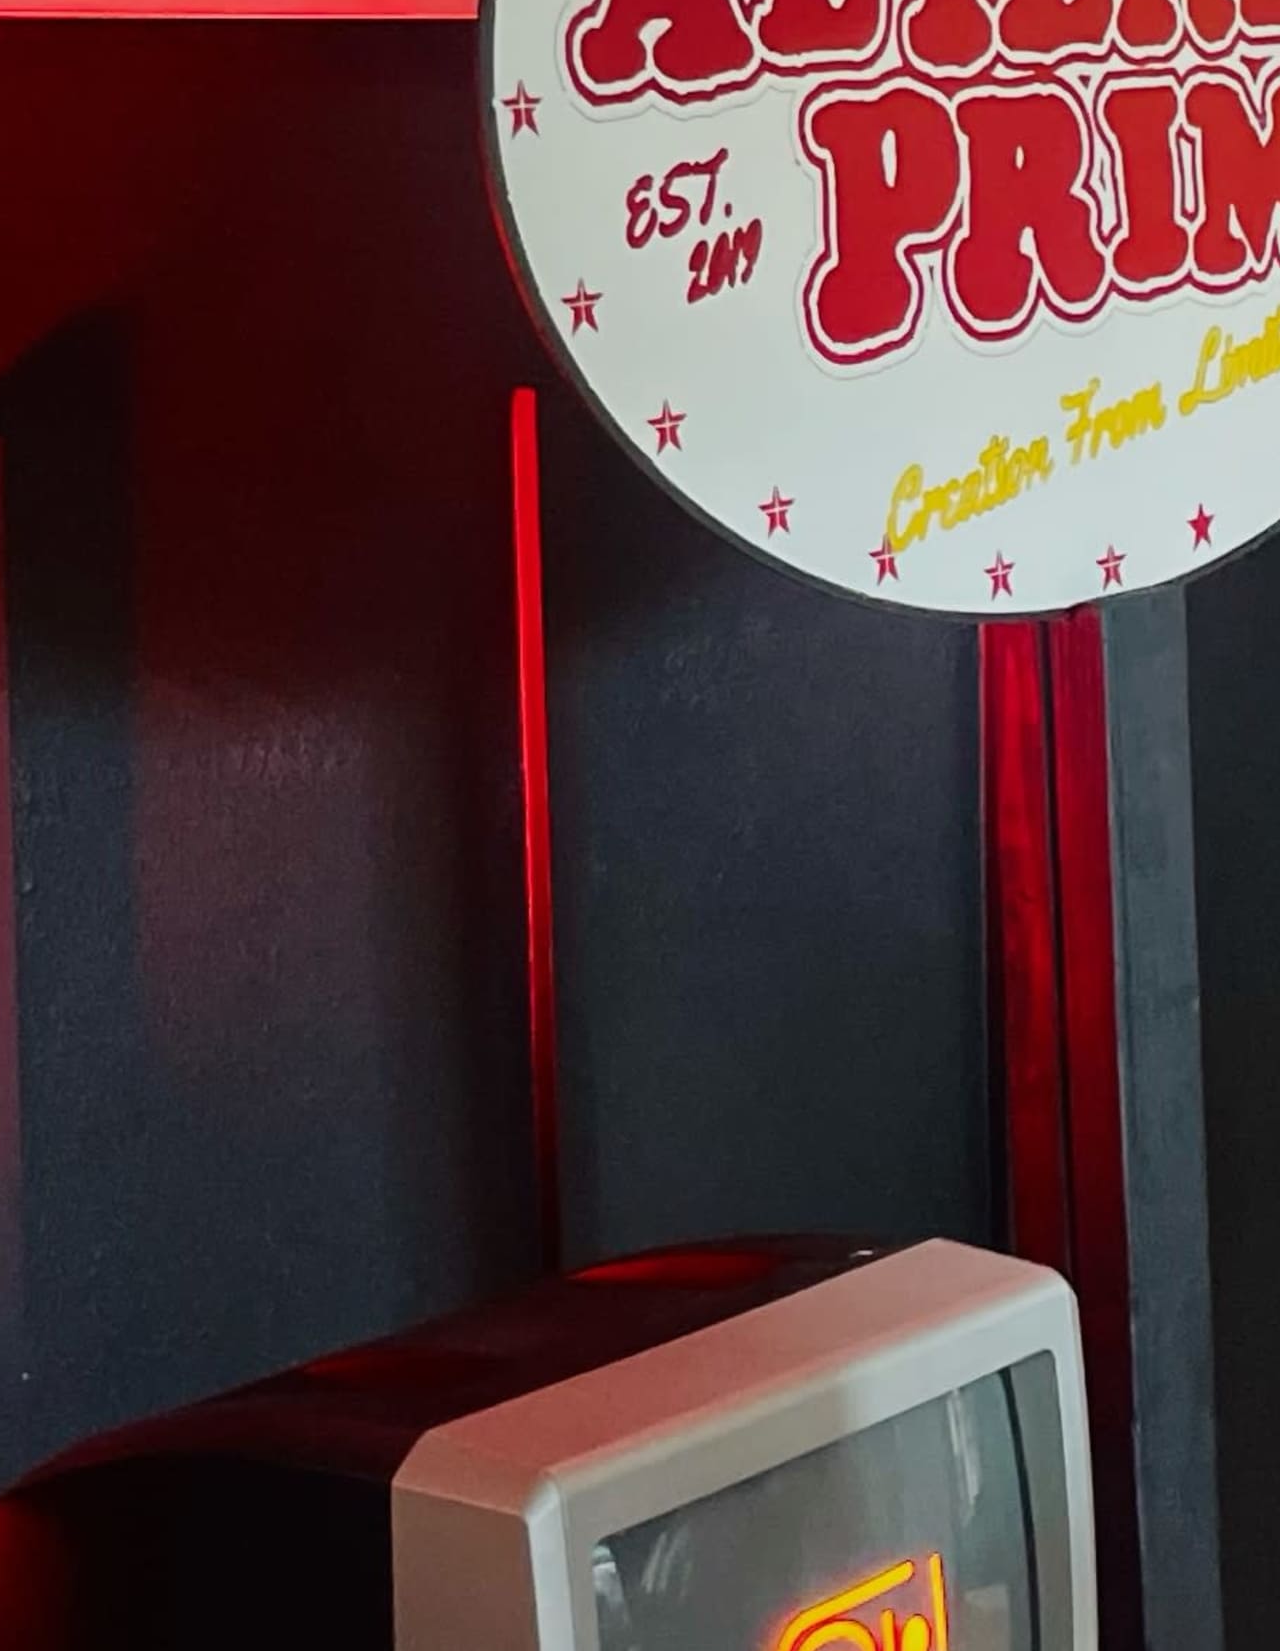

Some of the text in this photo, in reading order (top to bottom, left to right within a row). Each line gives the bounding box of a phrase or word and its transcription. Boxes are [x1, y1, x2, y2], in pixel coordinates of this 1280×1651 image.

[625, 147, 733, 249] EST.
[884, 434, 1054, 554] Creation
[1060, 377, 1165, 465] From
